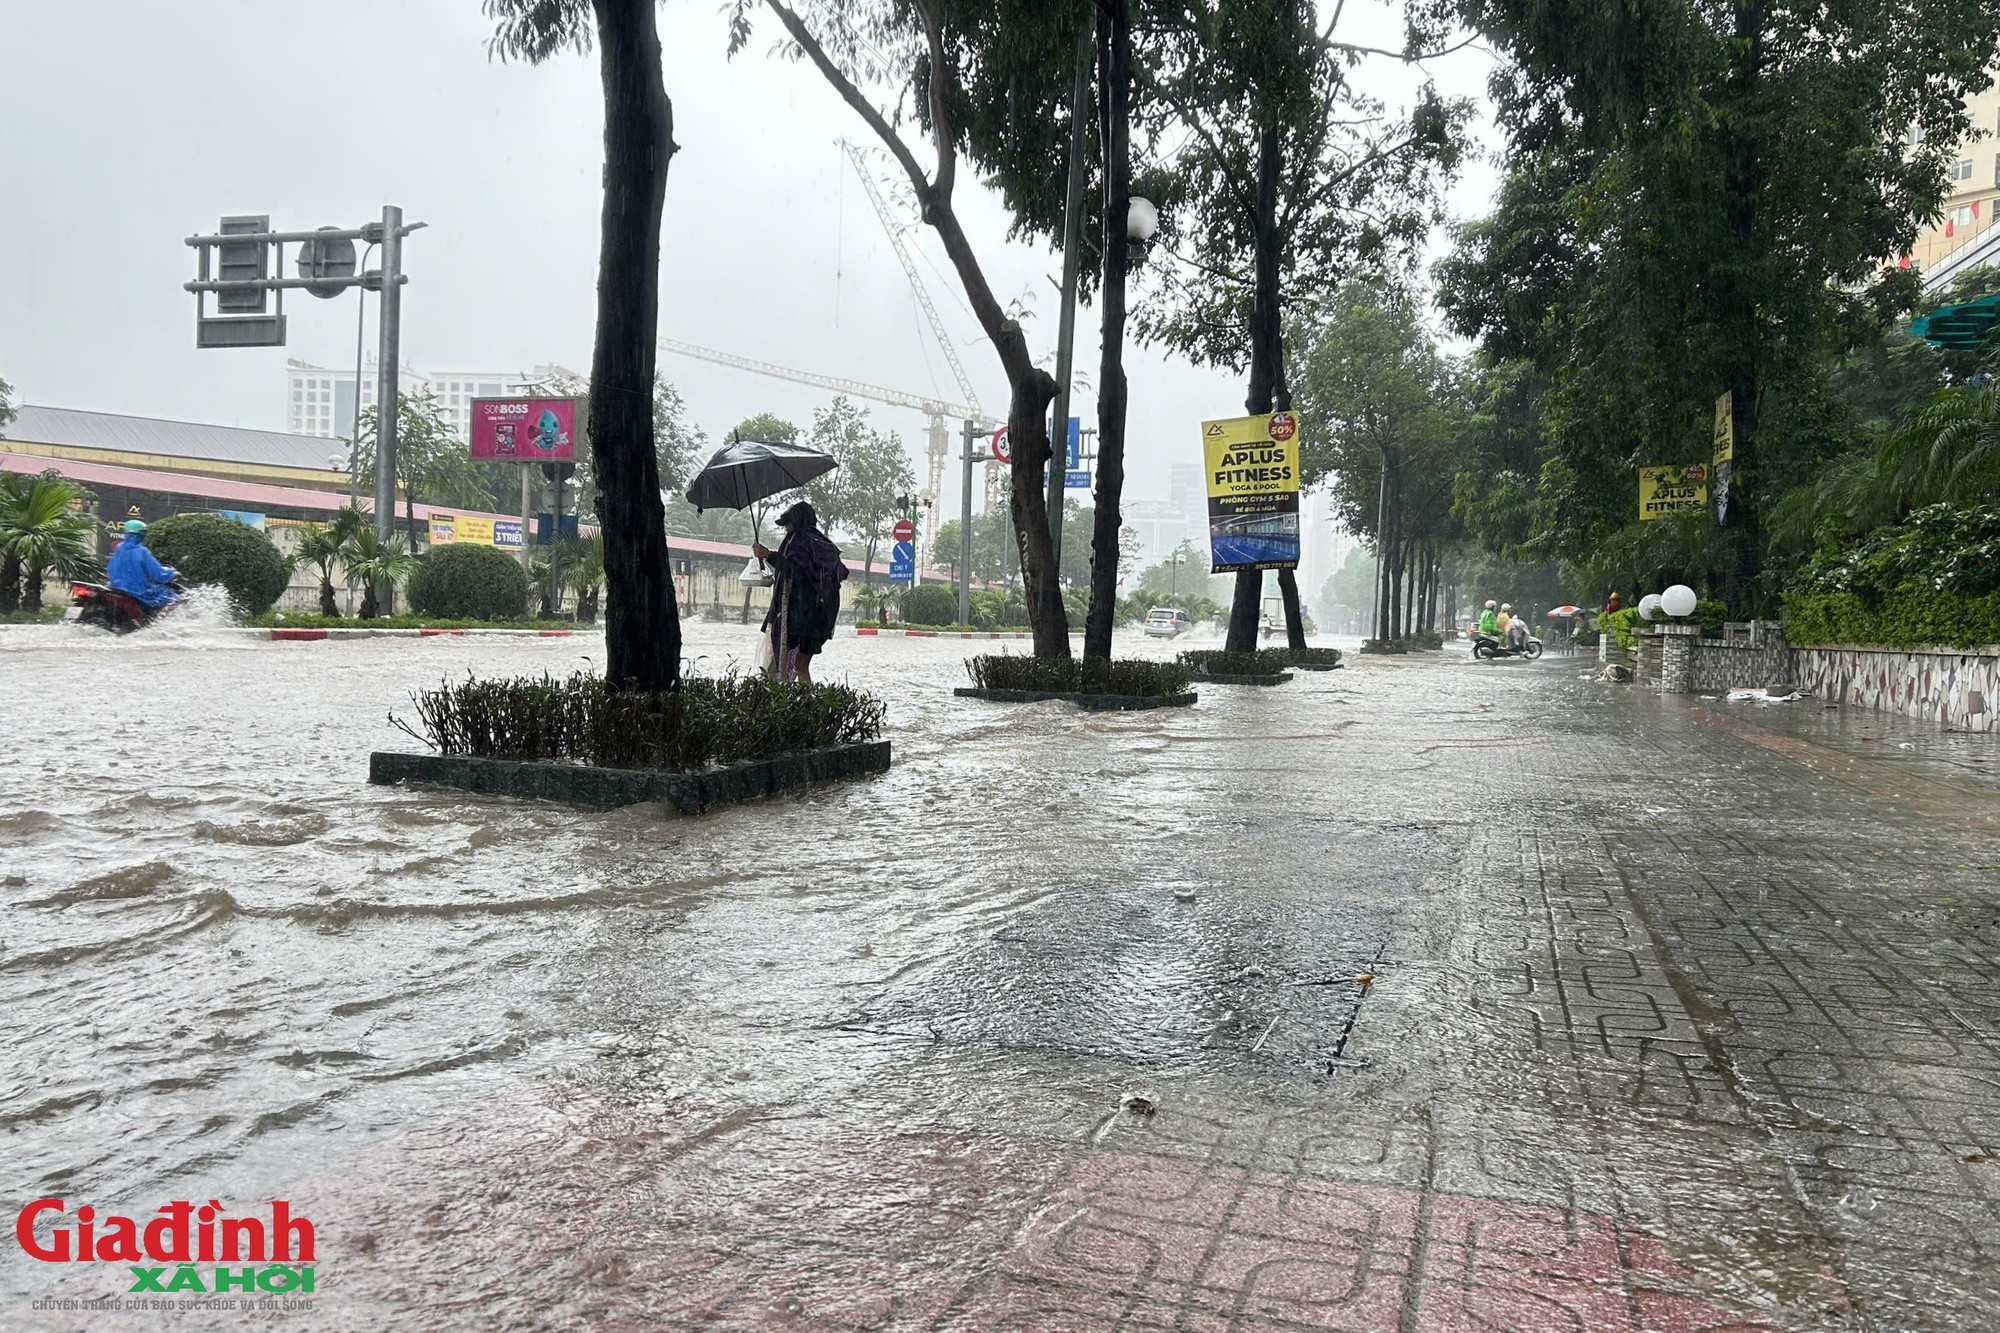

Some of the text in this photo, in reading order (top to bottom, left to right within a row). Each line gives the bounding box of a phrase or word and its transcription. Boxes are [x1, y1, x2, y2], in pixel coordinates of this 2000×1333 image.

[1270, 426, 1293, 435] 50%
[1221, 449, 1285, 467] APLUS
[1215, 466, 1292, 485] FITNESS
[1651, 488, 1696, 499] APLUS
[1220, 495, 1248, 504] PHÒNG
[1646, 500, 1701, 511] FITNESS
[496, 532, 501, 541] 3
